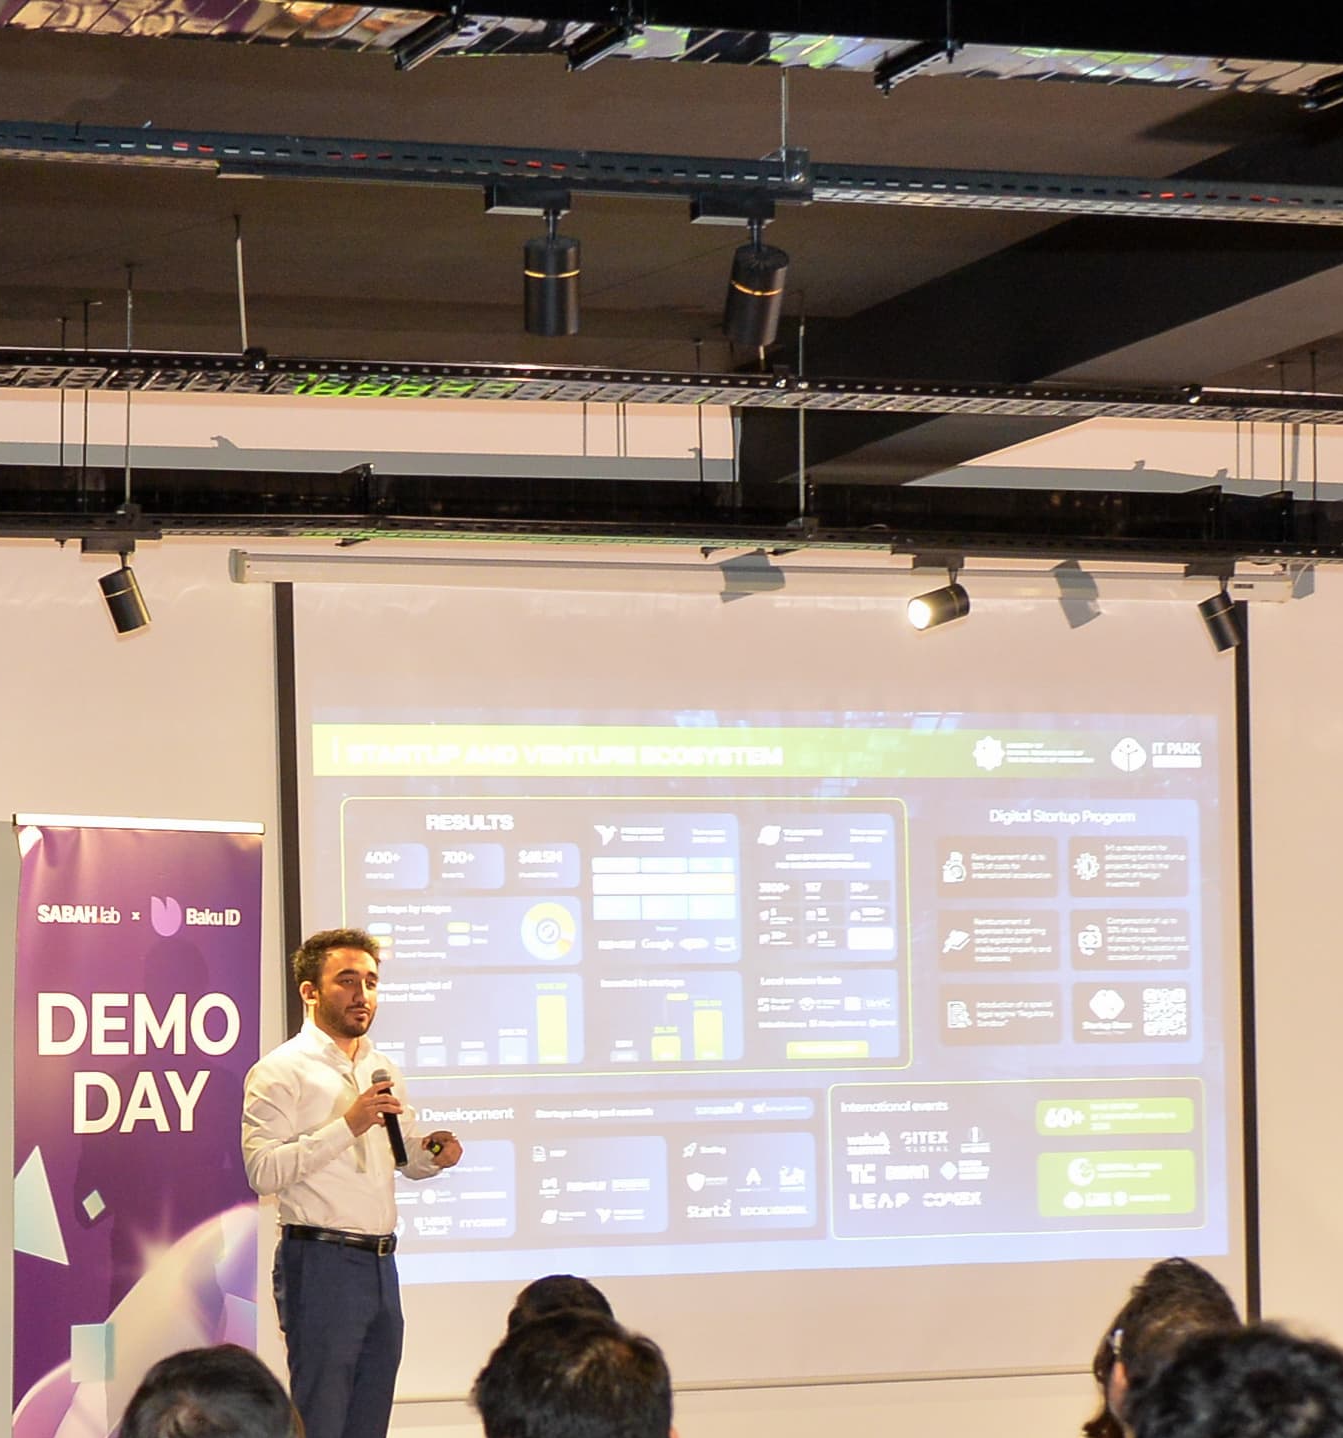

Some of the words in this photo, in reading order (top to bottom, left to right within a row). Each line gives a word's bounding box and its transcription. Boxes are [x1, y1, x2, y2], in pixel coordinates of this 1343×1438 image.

[345, 745, 460, 766] STARTUP
[465, 745, 518, 766] AND
[522, 745, 635, 766] VENTURE
[640, 745, 783, 766] ECOSYSTEM
[1167, 743, 1201, 754] PARK
[426, 814, 514, 831] RESULTS
[990, 810, 1031, 825] Digital
[1033, 810, 1080, 825] Startup
[1082, 811, 1136, 825] Program
[37, 904, 97, 924] SABAH
[185, 907, 223, 925] Baku
[224, 908, 241, 926] ID
[37, 992, 241, 1056] DEMO
[73, 1070, 210, 1134] DAY
[841, 1101, 911, 1113] International
[912, 1102, 949, 1112] events
[423, 1108, 514, 1123] Development
